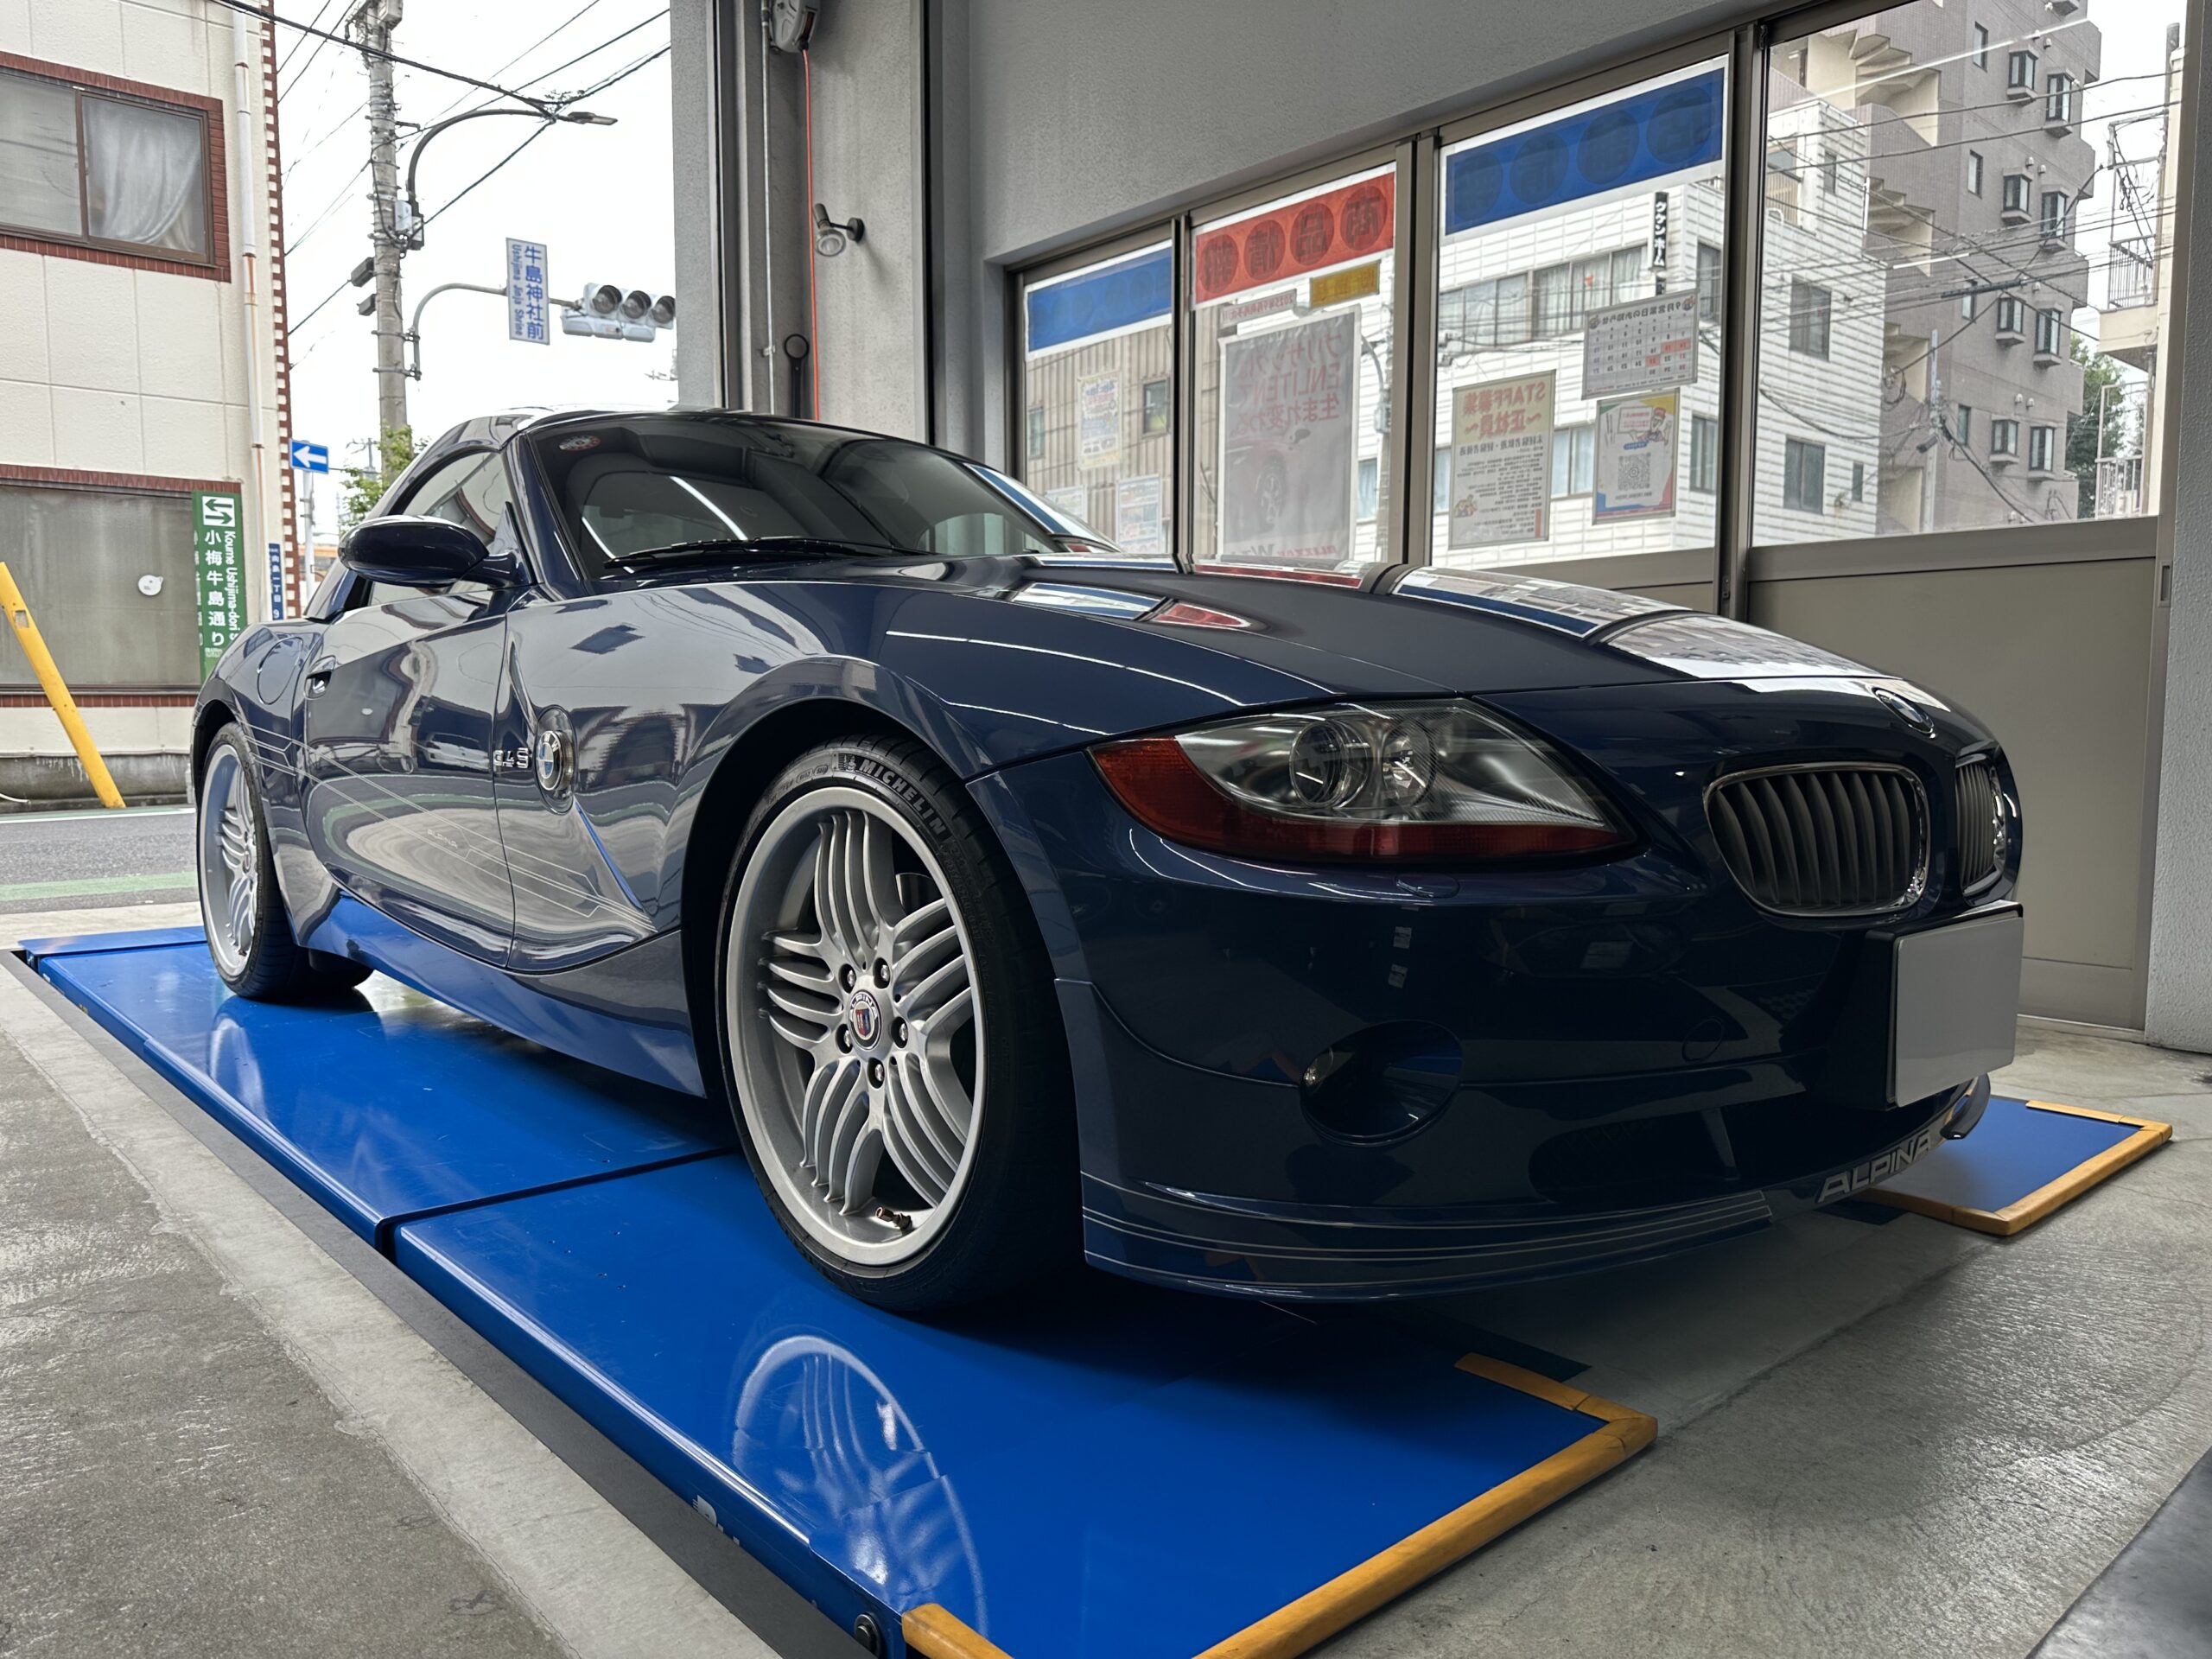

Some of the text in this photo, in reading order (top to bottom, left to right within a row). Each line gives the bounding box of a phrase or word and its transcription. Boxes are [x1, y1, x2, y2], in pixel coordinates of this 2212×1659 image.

[524, 245, 543, 340] 牛島神社前
[224, 530, 237, 565] Koume
[205, 530, 226, 646] 小梅牛島通り
[226, 567, 240, 632] Ushijima-dori
[273, 608, 280, 619] 9
[859, 758, 948, 839] MICHELIN
[1817, 1129, 1933, 1204] ALPINA
